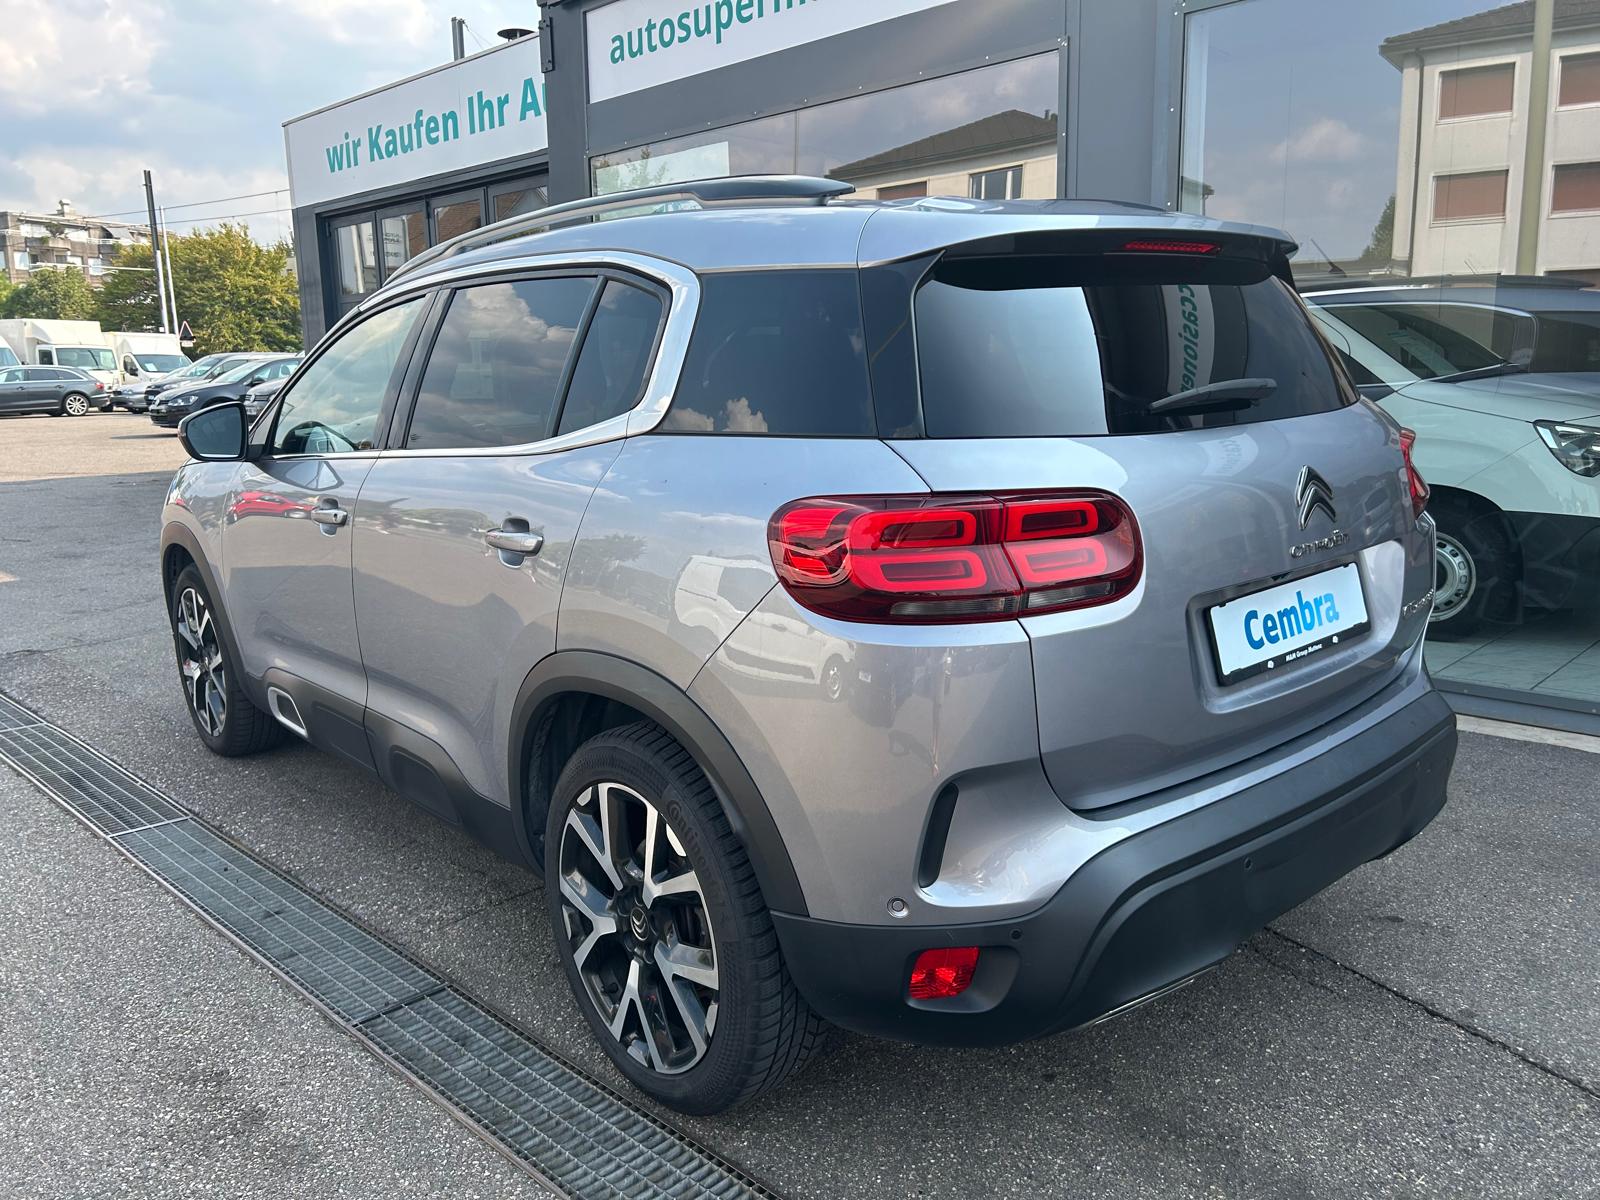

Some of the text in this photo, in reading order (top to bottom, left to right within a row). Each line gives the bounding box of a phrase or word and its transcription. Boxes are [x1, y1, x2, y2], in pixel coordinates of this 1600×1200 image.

[610, 0, 806, 65] autosupe
[326, 77, 547, 173] wir Kaufen Ihr A
[1244, 591, 1339, 650] Cembra
